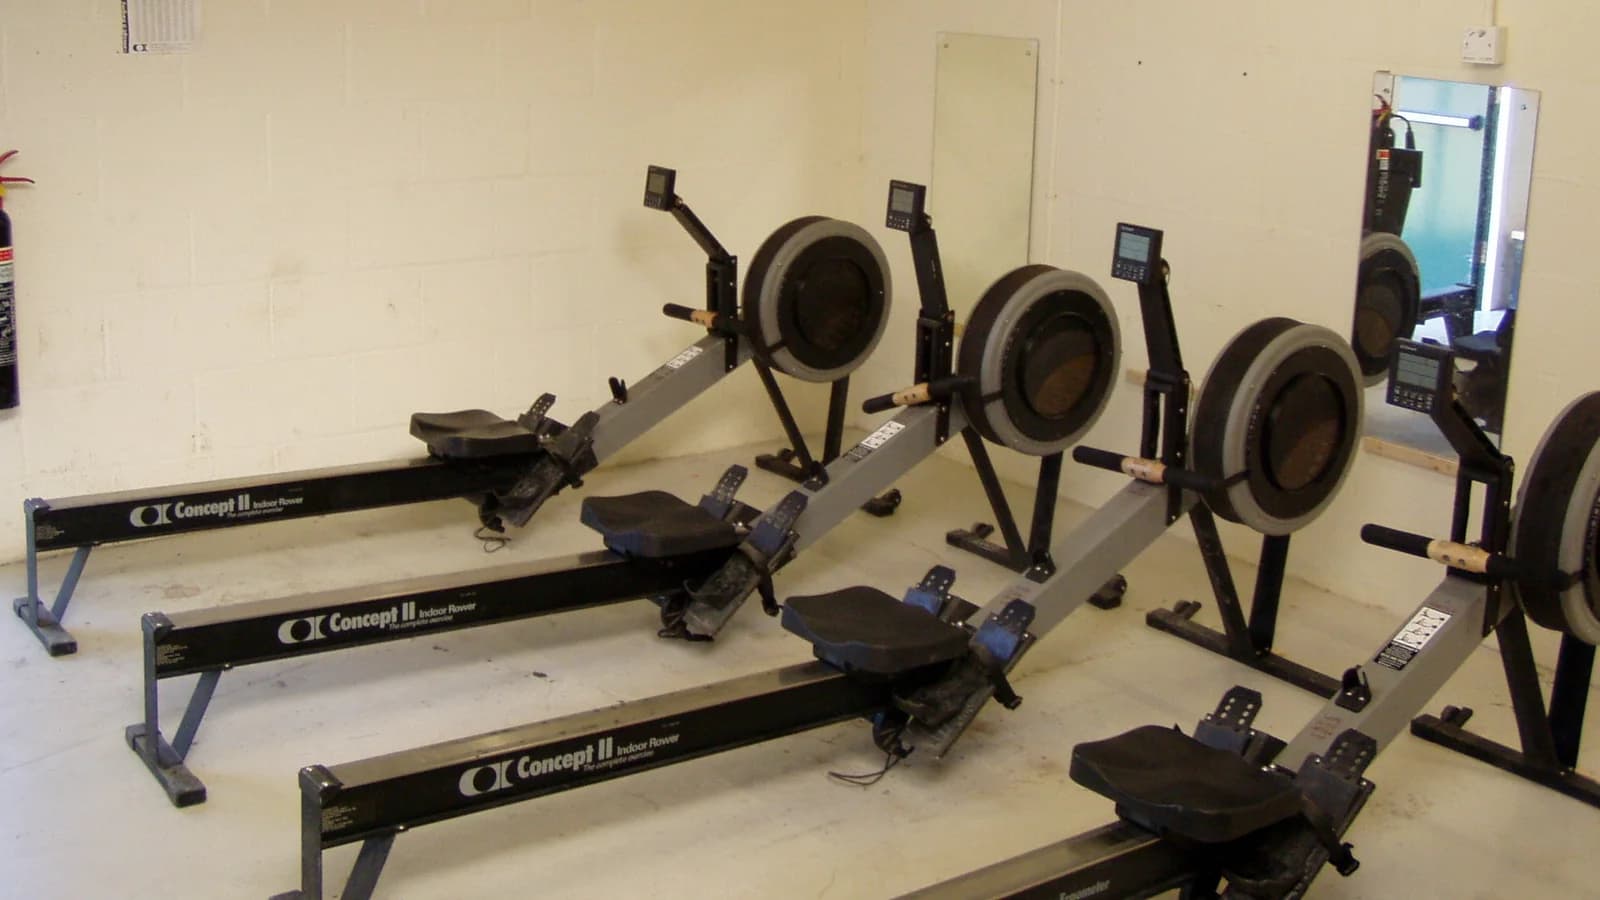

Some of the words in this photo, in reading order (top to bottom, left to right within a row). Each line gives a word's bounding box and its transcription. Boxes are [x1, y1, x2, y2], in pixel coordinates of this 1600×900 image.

[175, 498, 235, 519] Concept
[330, 606, 399, 633] Concept
[419, 607, 447, 618] Indoor
[448, 602, 477, 614] Rower
[517, 744, 594, 779] Concept
[617, 743, 648, 757] Indoor
[648, 733, 680, 749] Rower
